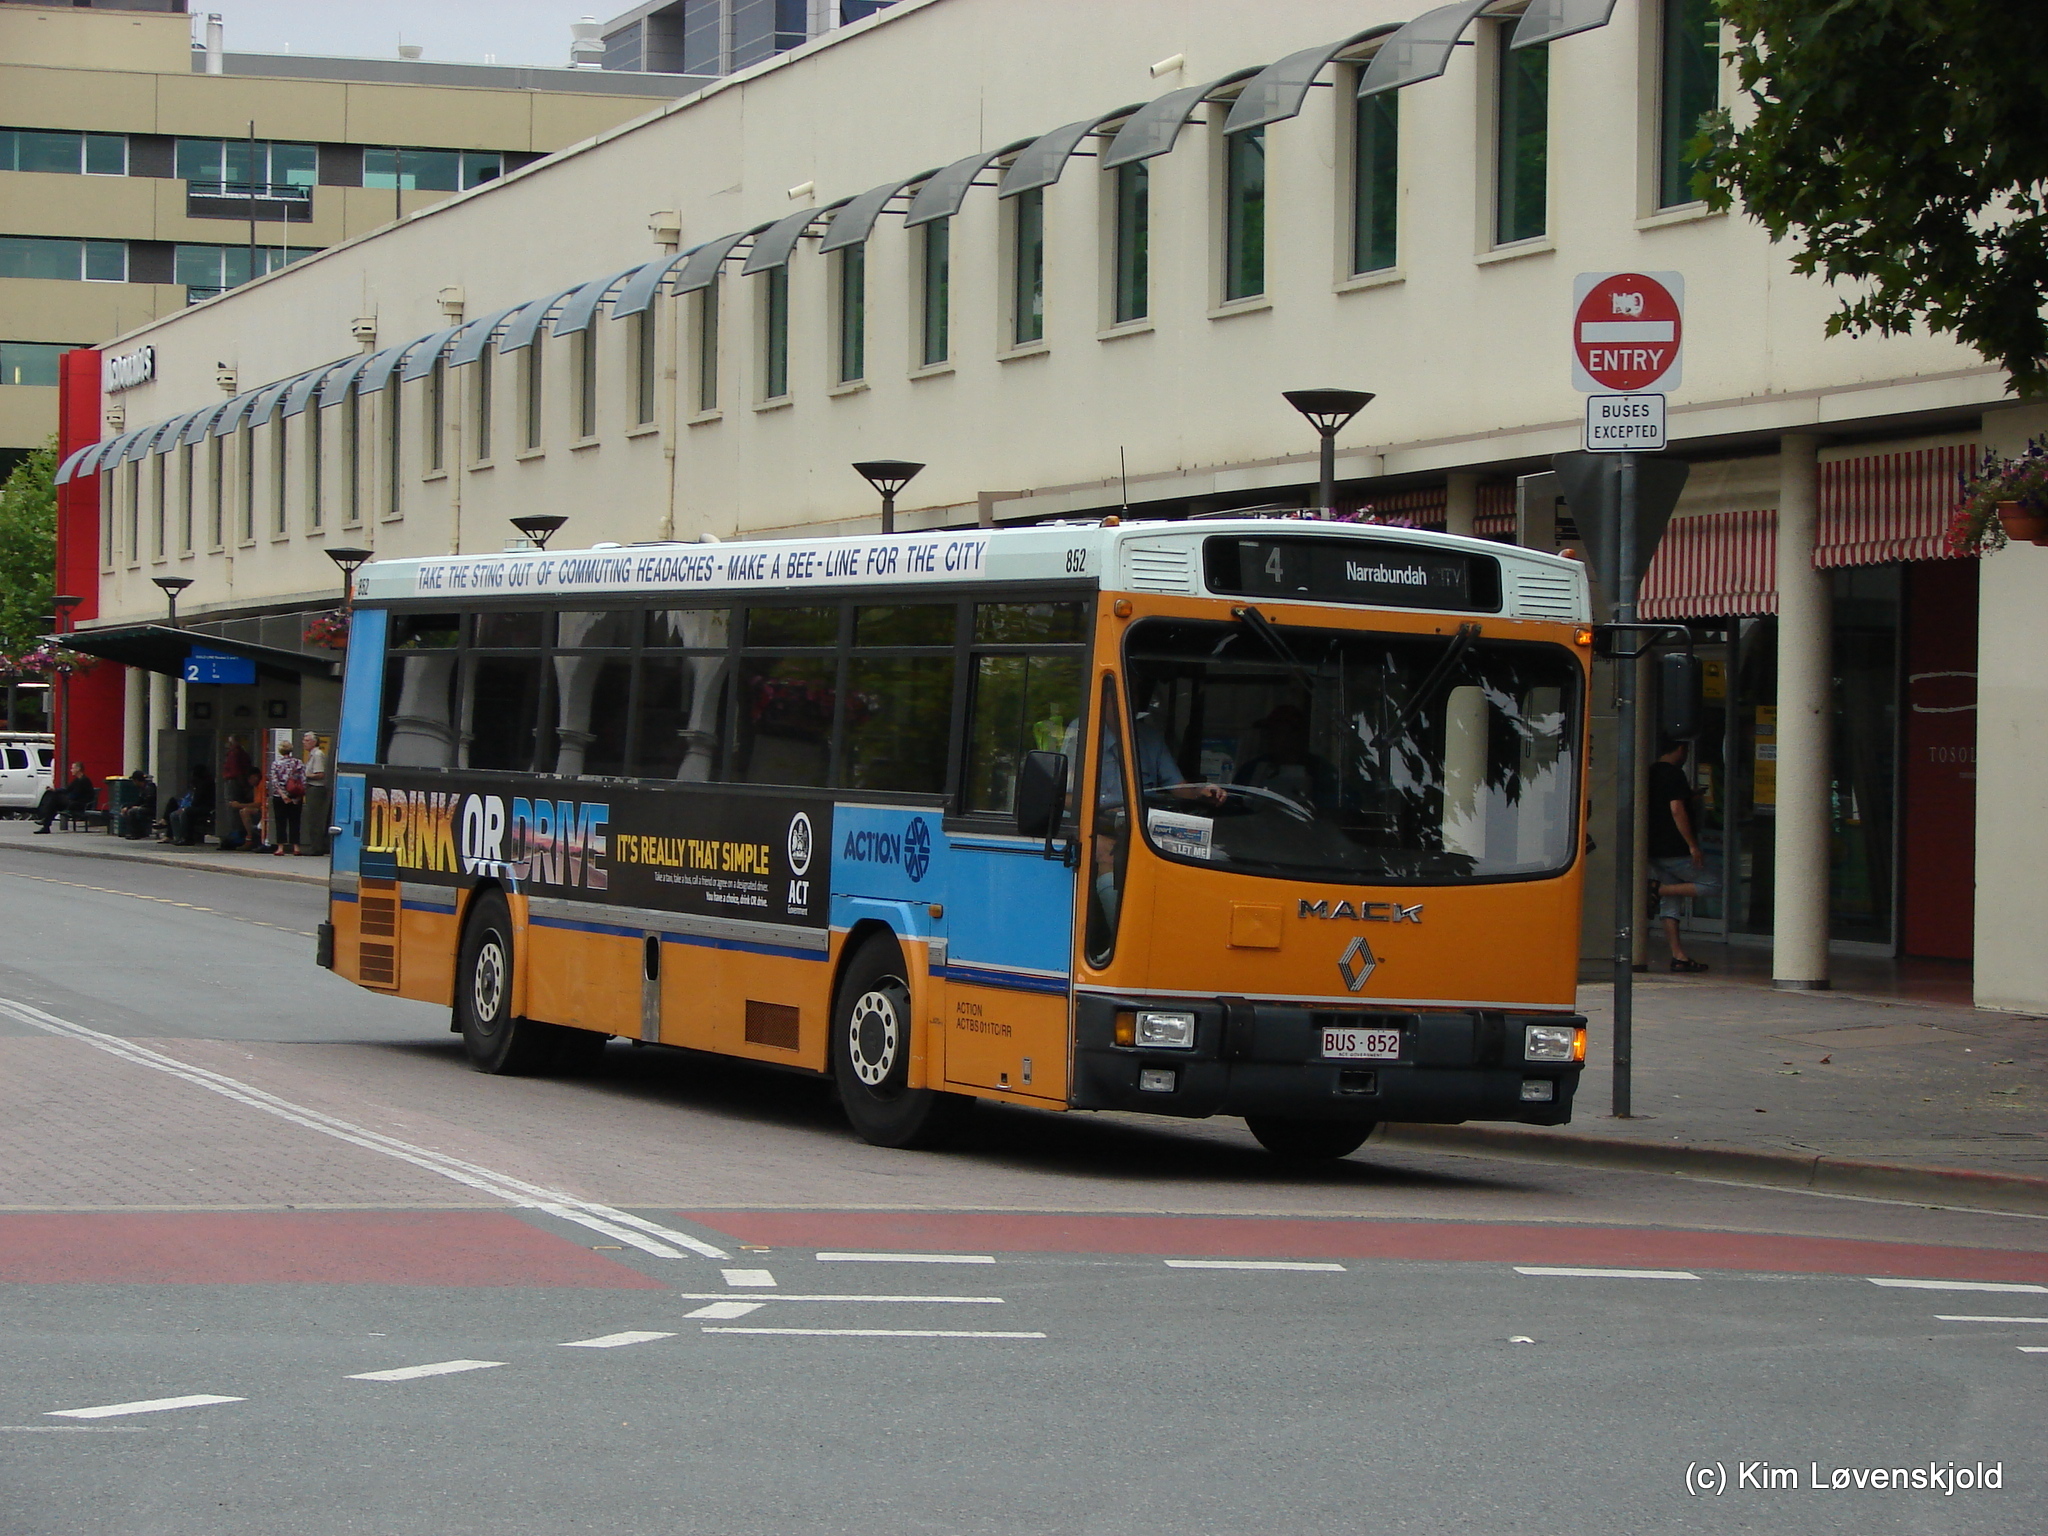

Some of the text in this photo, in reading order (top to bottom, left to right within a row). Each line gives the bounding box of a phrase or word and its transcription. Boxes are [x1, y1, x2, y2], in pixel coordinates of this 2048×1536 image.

[1589, 349, 1664, 372] ENTRY
[1602, 404, 1650, 418] BUSES
[1594, 424, 1657, 439] EXCEPTED
[419, 564, 443, 590] TAKE
[448, 564, 470, 588] THE
[471, 563, 503, 588] STING
[508, 562, 533, 587] OUT
[536, 560, 552, 585] OF
[558, 557, 631, 584] COMMUTING
[636, 554, 715, 583] HEADACHES
[727, 553, 767, 581] MAKE
[770, 553, 781, 579] A
[866, 546, 900, 576] FOR
[906, 544, 939, 573] THE
[944, 541, 986, 571] CITY
[1066, 548, 1087, 573] 852
[1265, 547, 1283, 583] 4
[1346, 560, 1461, 587] Narrabundah ITY
[187, 665, 199, 681] 2
[367, 787, 609, 890] DRINK OR DRIVE
[843, 830, 901, 865] ACTION
[1178, 844, 1192, 856] LET
[616, 834, 770, 876] IT'S REALLY THAT SIMPLE
[788, 879, 810, 905] ACT
[1298, 899, 1423, 924] MACK
[957, 1001, 983, 1017] ACTION
[956, 1017, 979, 1032] ACTBS
[1325, 1033, 1398, 1053] BUS 852
